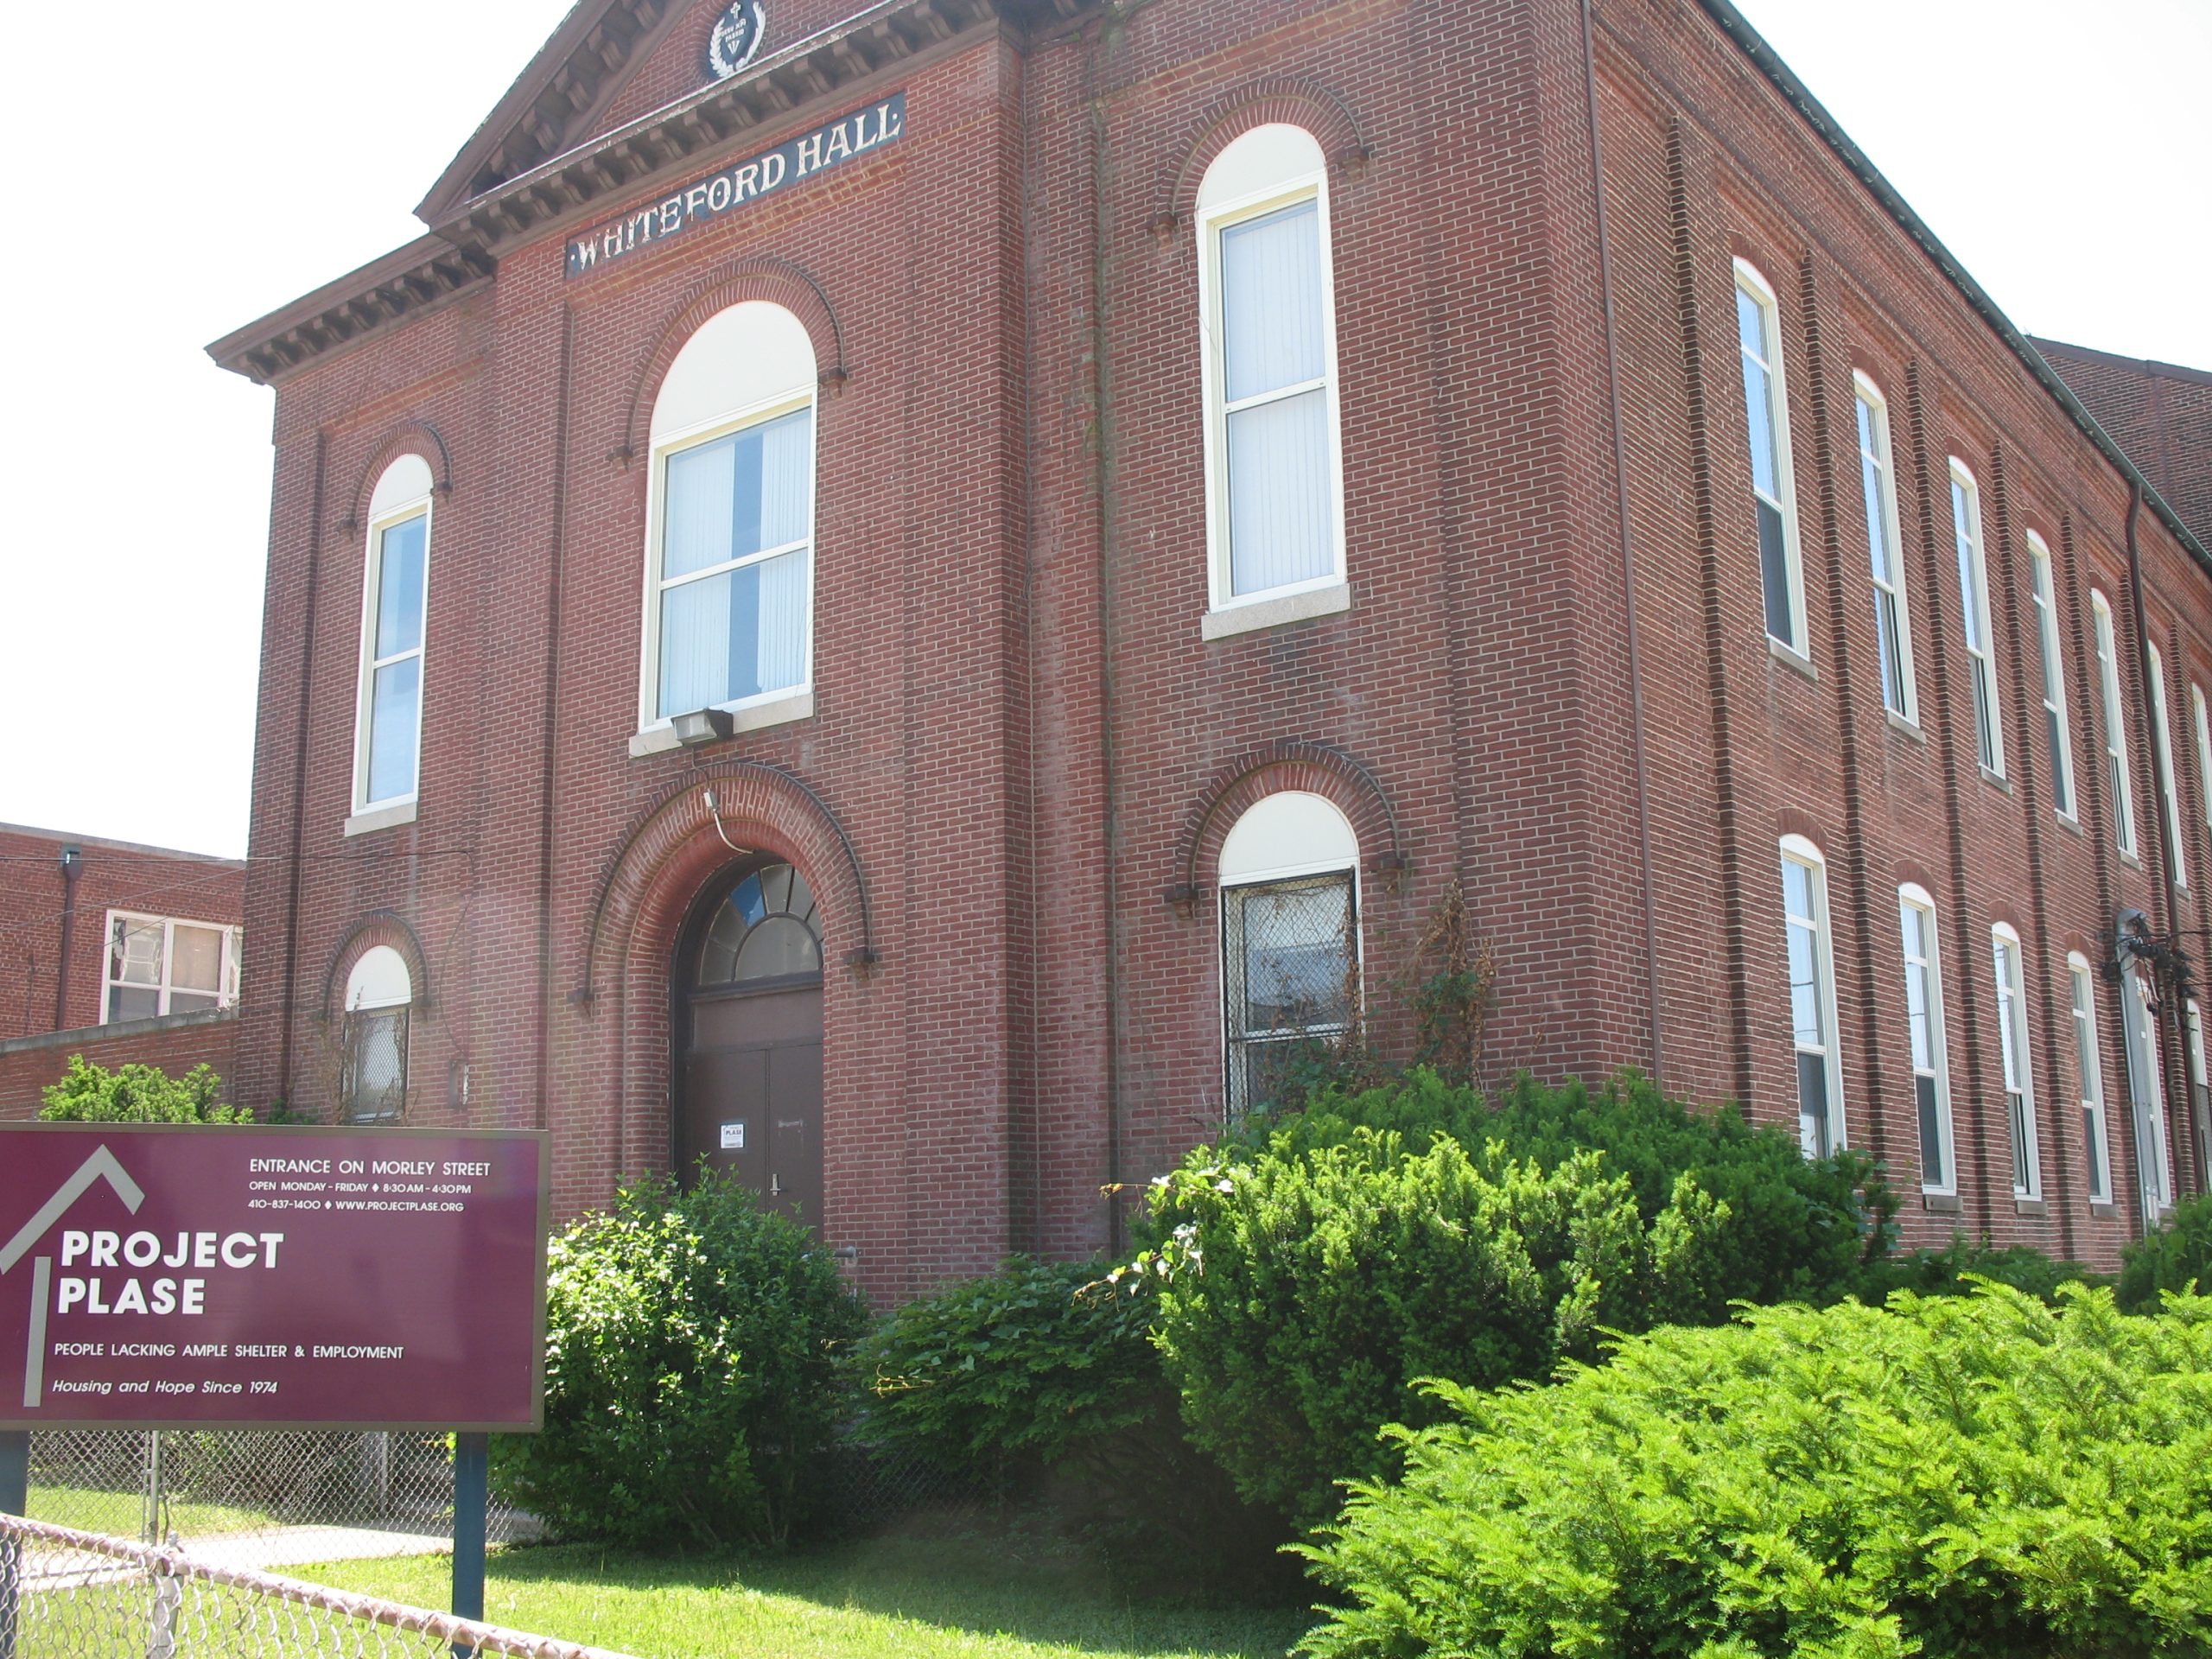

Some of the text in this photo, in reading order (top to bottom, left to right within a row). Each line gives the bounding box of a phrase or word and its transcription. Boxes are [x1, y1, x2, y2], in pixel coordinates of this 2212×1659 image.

[578, 104, 901, 270] WHITEFORD HALL
[250, 1159, 491, 1176] ENTRANCE ON MORLEY STREET
[249, 1181, 276, 1191] OPEN
[248, 1199, 465, 1212] 410-837-1400 WWW.PROJECTPLASE.ORG
[61, 1230, 284, 1268] PROJECT
[58, 1277, 206, 1315] PLASE
[54, 1343, 404, 1359] PEOPLE LACKING AMPLE SHELTER & EMPLOYMENT
[53, 1380, 278, 1395] Housing and Hope Since 1974
